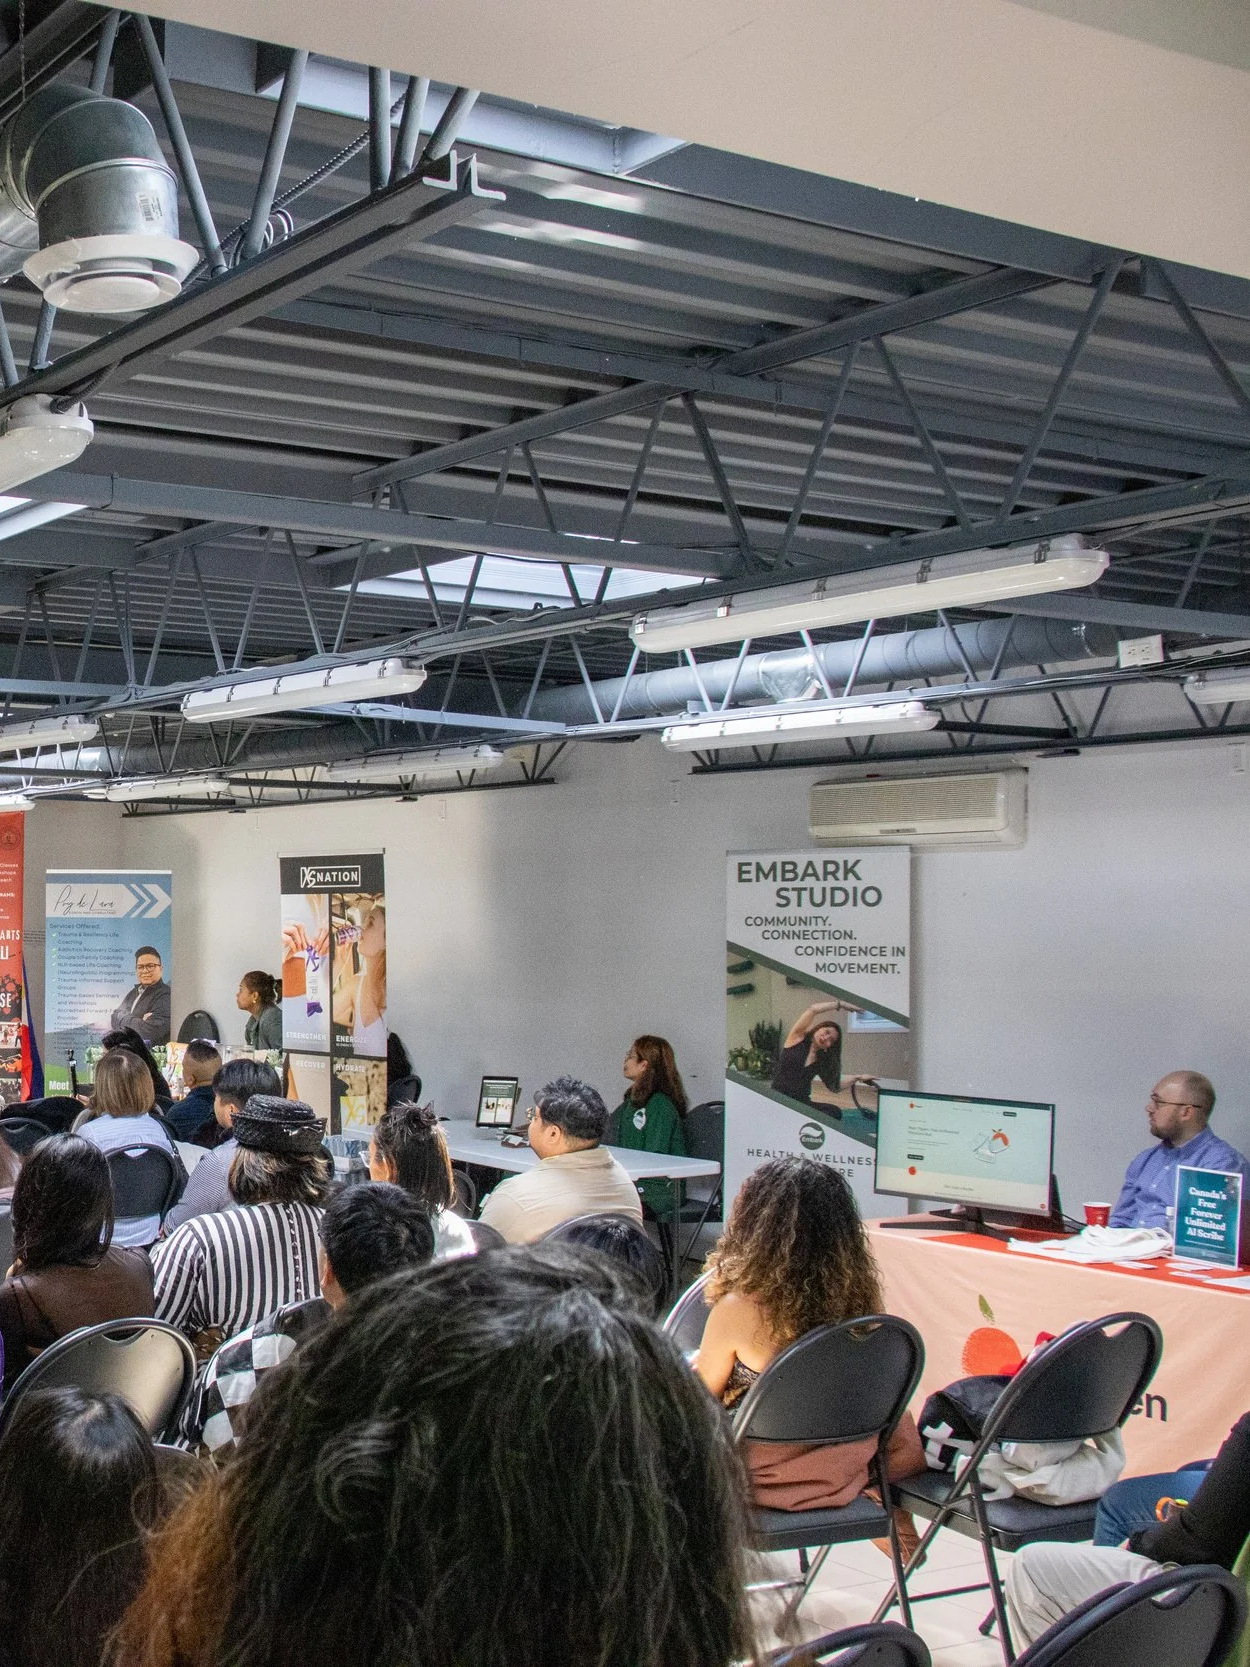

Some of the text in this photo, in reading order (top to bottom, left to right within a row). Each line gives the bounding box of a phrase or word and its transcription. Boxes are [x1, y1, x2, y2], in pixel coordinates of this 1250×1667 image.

[316, 871, 358, 882] NATION
[737, 859, 862, 883] EMBARK
[775, 886, 883, 908] STUDIO
[744, 916, 832, 927] COMMUNITY.
[0, 929, 20, 941] ARTS
[761, 929, 857, 941] CONNECTION.
[794, 945, 906, 957] CONFIDENCE IN
[815, 962, 901, 974] MOVEMENT.
[286, 1032, 327, 1041] STRENGTHEN
[295, 1059, 326, 1069] RECOVER
[336, 1063, 367, 1073] HYDRATE
[48, 1080, 70, 1091] Meet
[747, 1148, 794, 1159] HEALTH
[812, 1153, 876, 1166] WELLNES
[1188, 1186, 1227, 1200] Canada's
[1198, 1198, 1217, 1209] Free
[1190, 1207, 1223, 1220] Forever
[1184, 1216, 1226, 1231] Unlimited
[1187, 1227, 1225, 1241] AI Scribe
